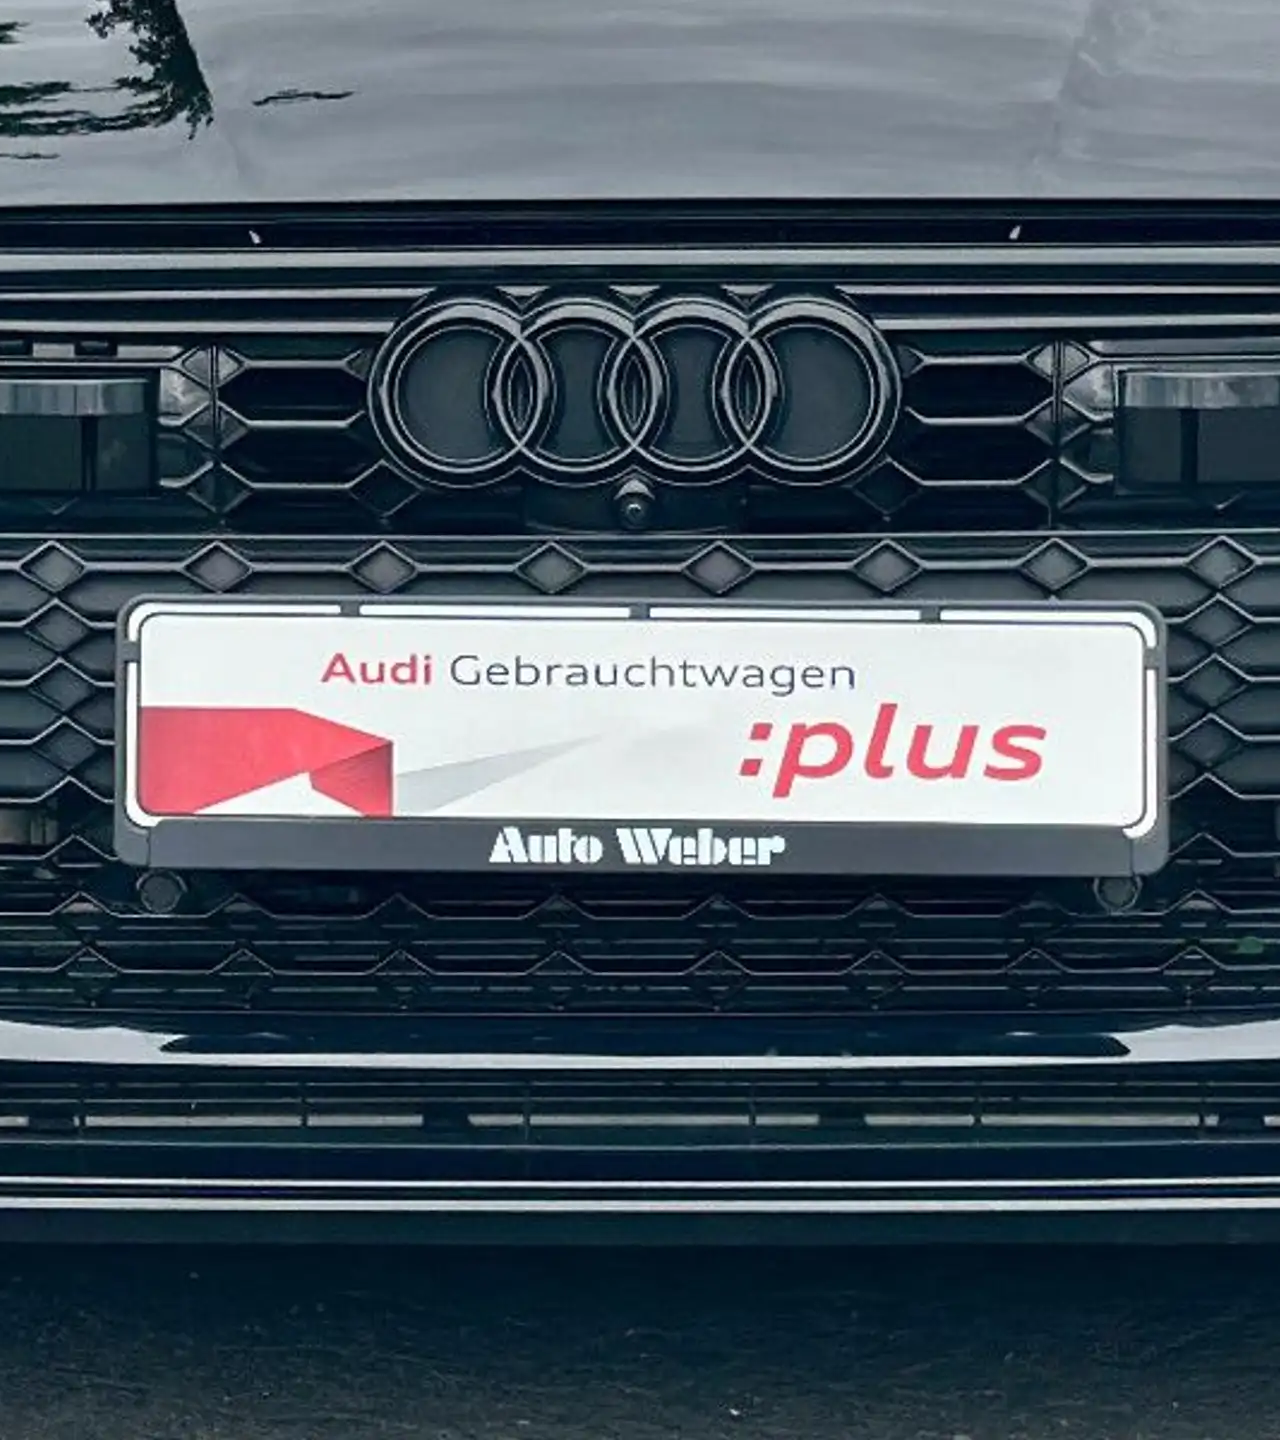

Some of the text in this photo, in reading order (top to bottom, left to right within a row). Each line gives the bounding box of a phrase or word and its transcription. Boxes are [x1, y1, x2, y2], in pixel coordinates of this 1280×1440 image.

[320, 652, 856, 698] Audi Gebrauchtwagen
[739, 702, 1048, 798] :plus
[487, 826, 787, 867] Auto Weber
